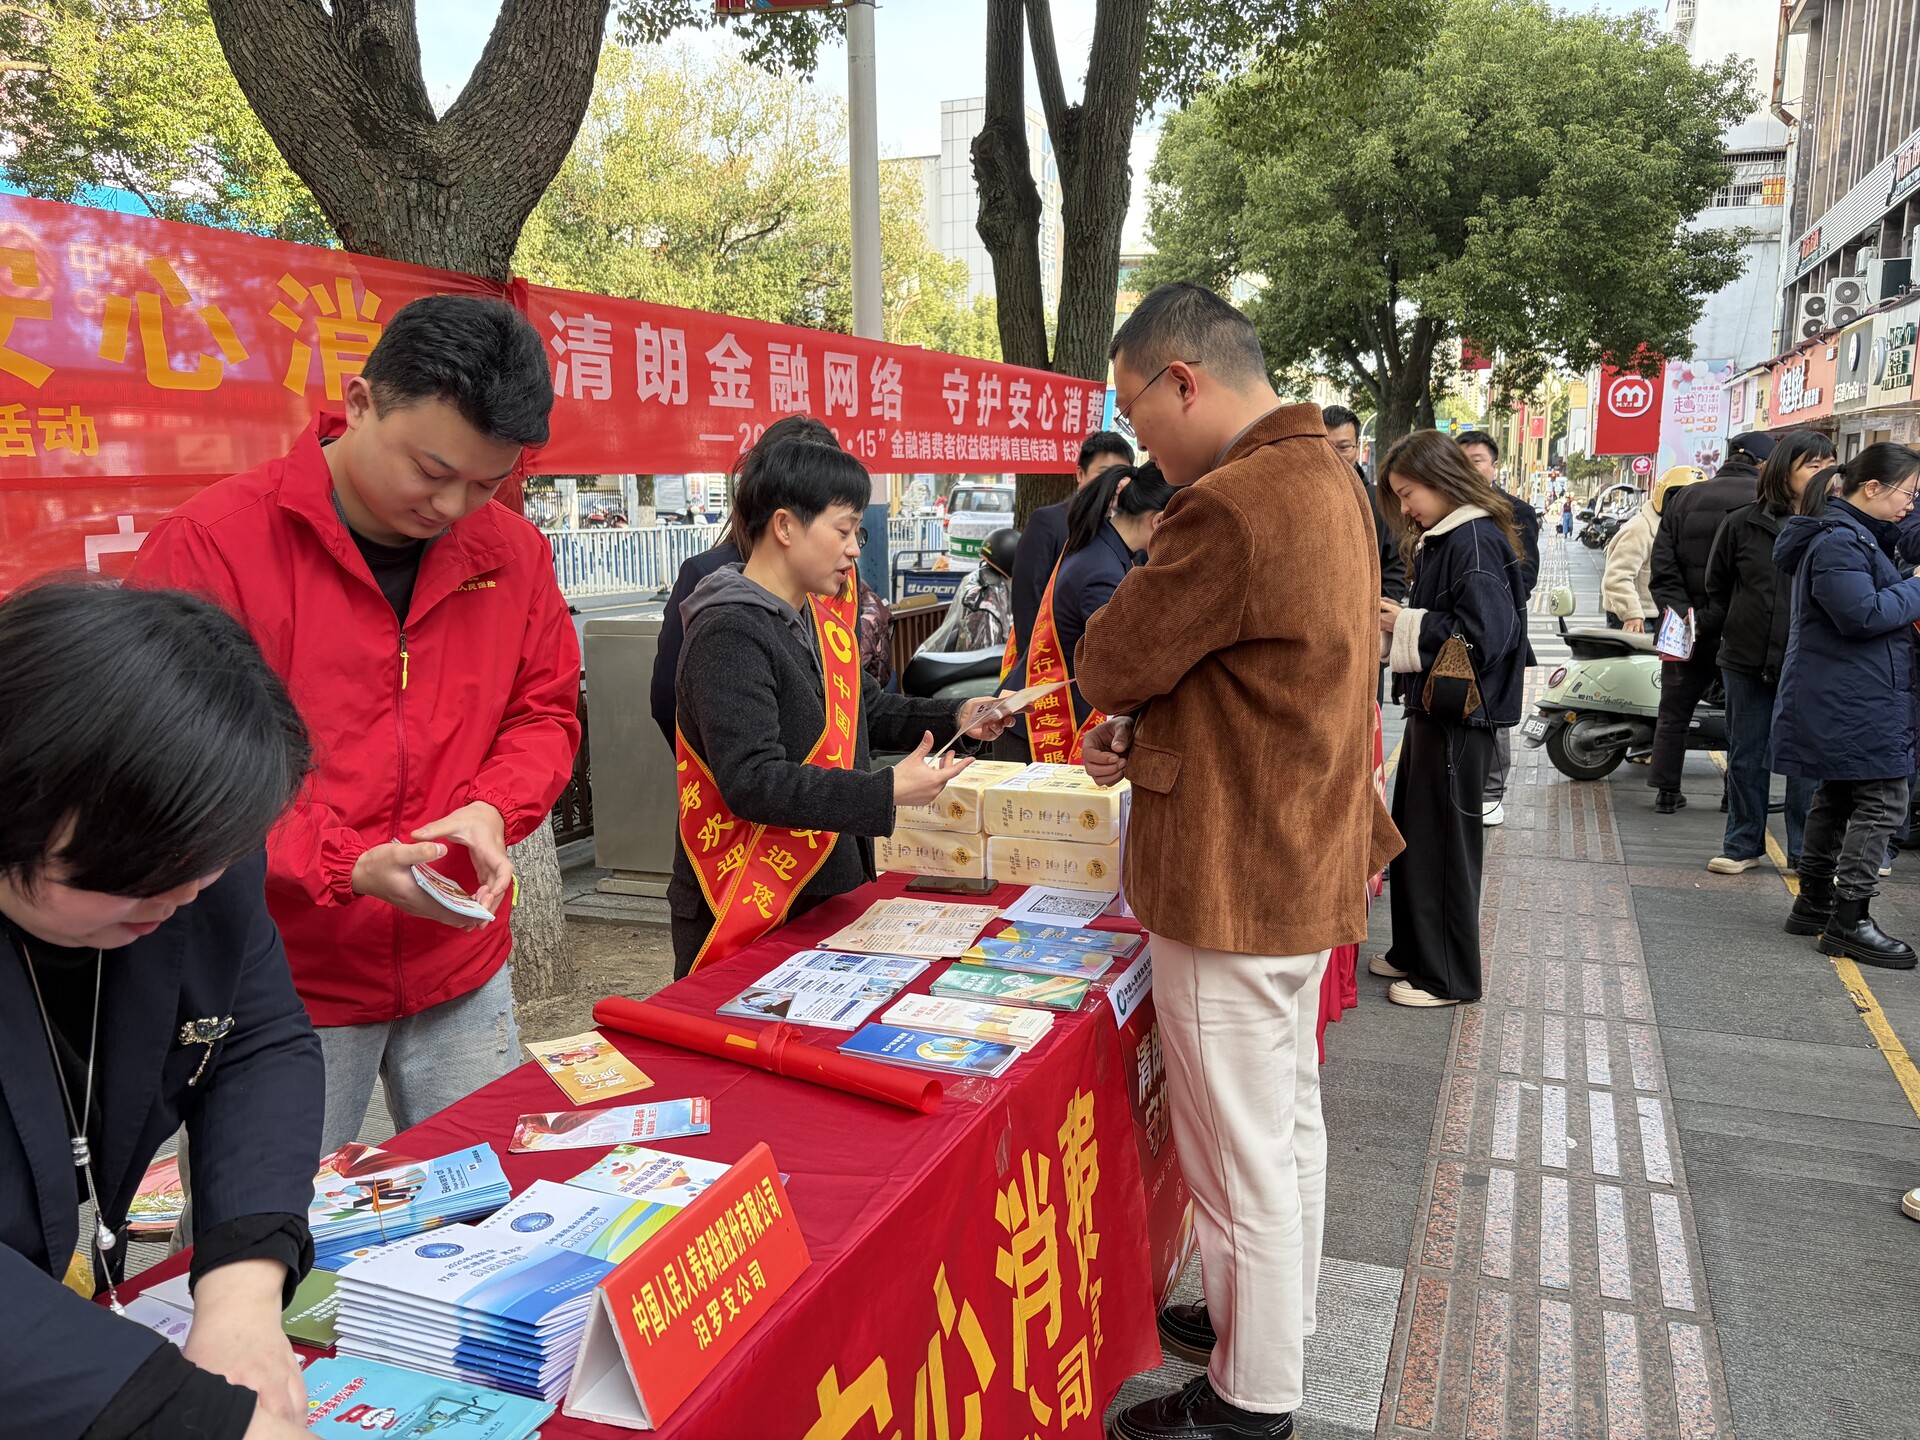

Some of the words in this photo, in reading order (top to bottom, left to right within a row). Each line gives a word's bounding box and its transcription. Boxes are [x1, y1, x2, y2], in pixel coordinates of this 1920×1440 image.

[549, 309, 905, 422] 清朗金融网络
[941, 366, 1106, 434] 守护安心消费
[455, 580, 496, 591] 人民保险
[916, 585, 956, 594] LONCIN
[1524, 719, 1546, 737] 爱玛
[677, 759, 746, 882] 寿欢迎
[439, 1175, 451, 1194] Beware
[632, 1176, 782, 1347] 中国人民人寿保险股份有限公司
[691, 1259, 767, 1351] 汨罗支公司
